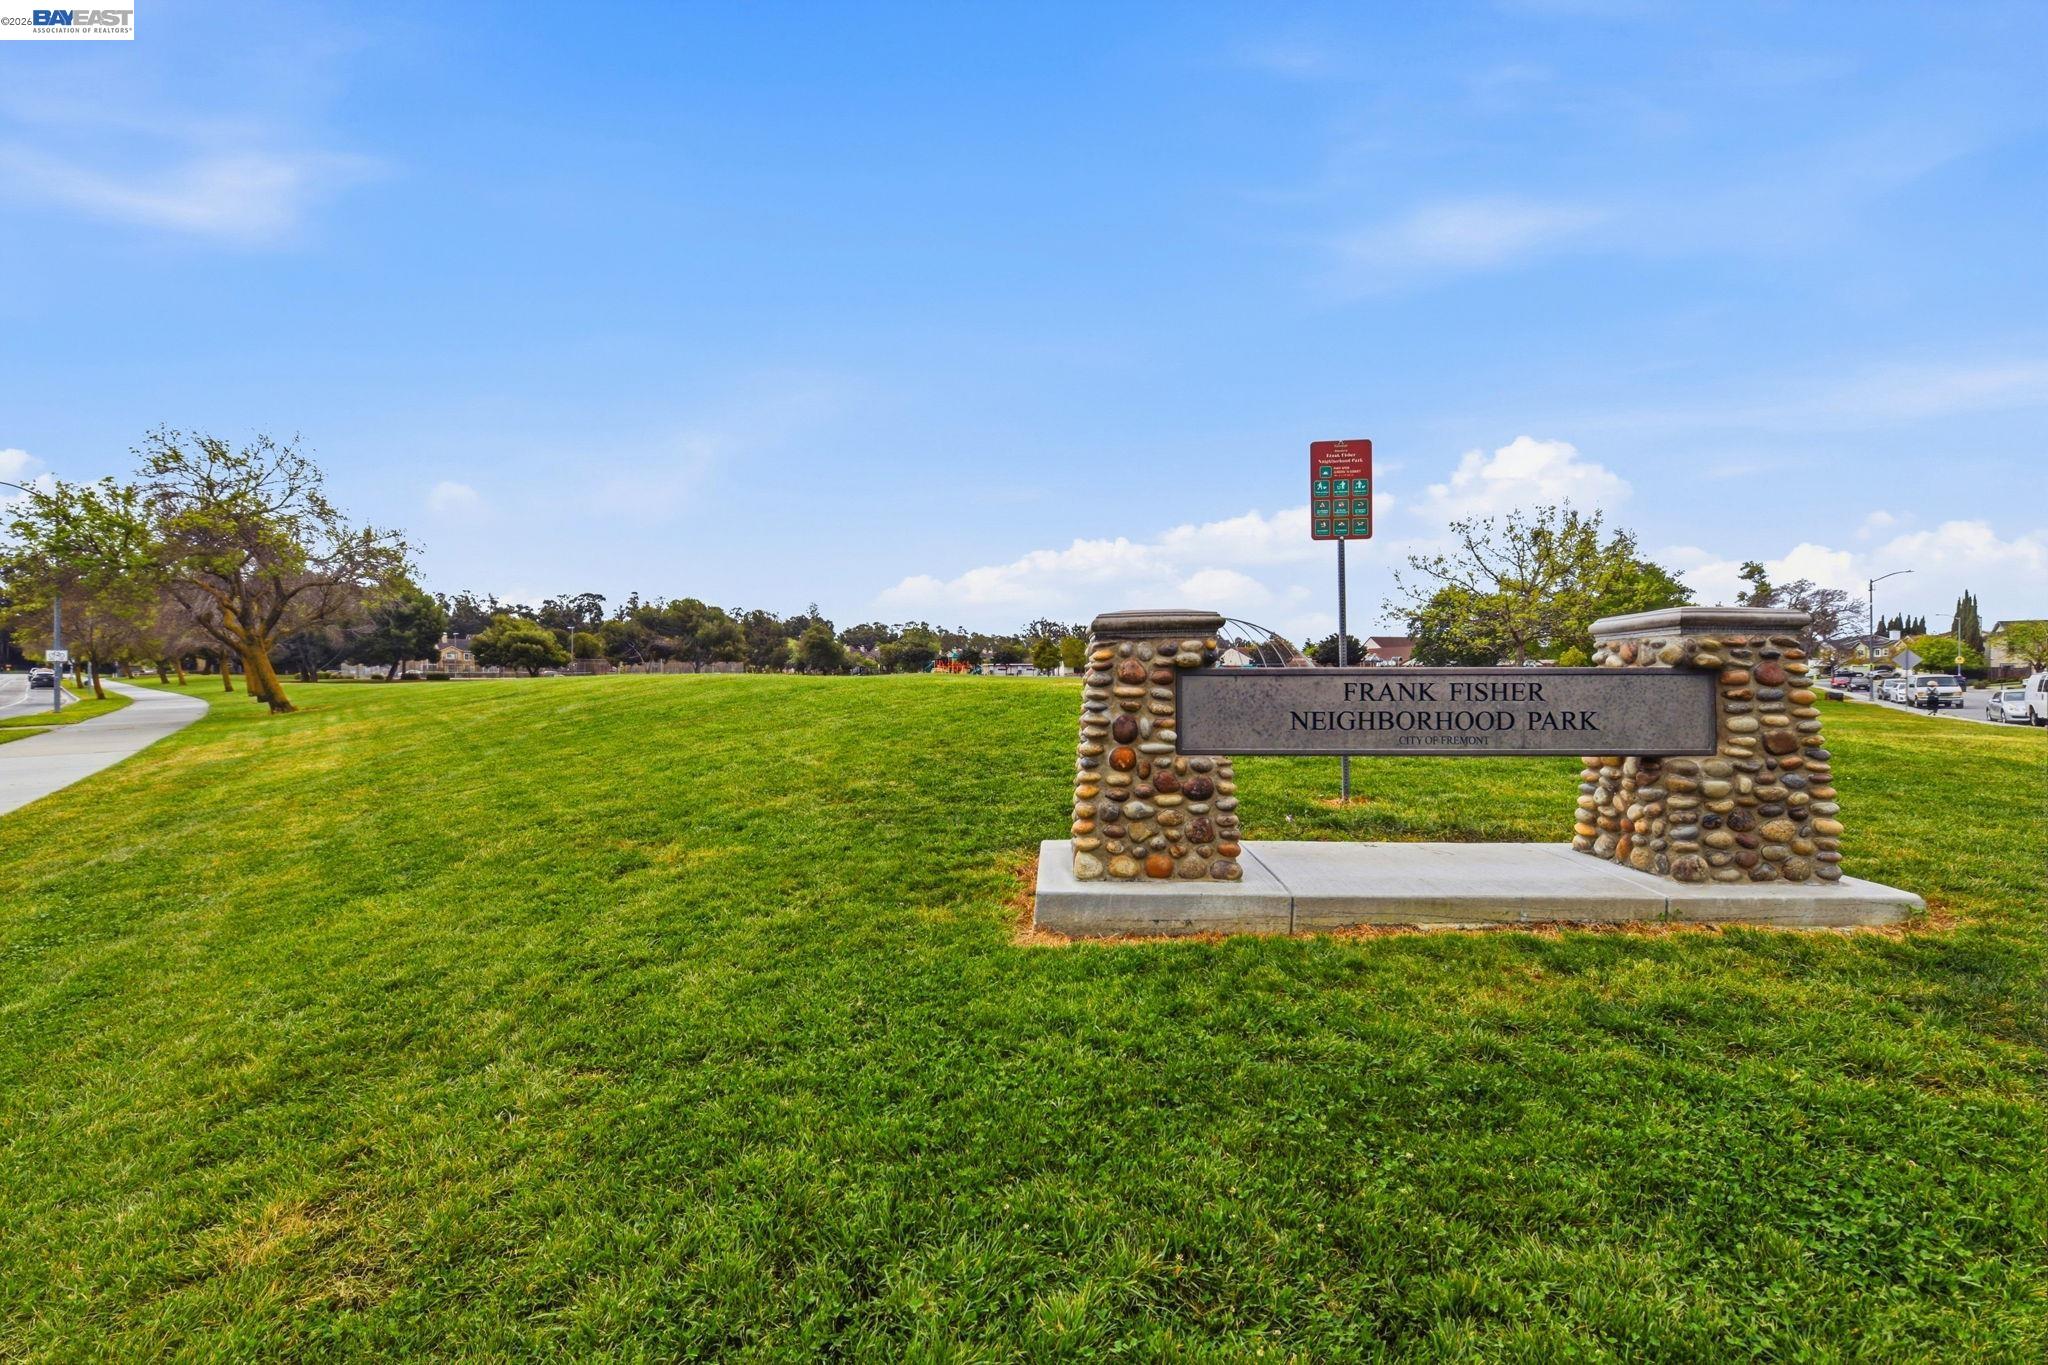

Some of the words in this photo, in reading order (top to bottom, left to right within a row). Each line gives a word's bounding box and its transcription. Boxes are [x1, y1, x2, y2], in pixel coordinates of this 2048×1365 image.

[1343, 682, 1437, 702] FRANK
[1449, 682, 1546, 702] FISHER
[1290, 711, 1516, 731] NEIGHBORHOOD
[1527, 711, 1600, 731] PARK
[1398, 735, 1422, 746] CITY
[1425, 735, 1439, 745] OF
[1441, 735, 1489, 745] FREMONT
